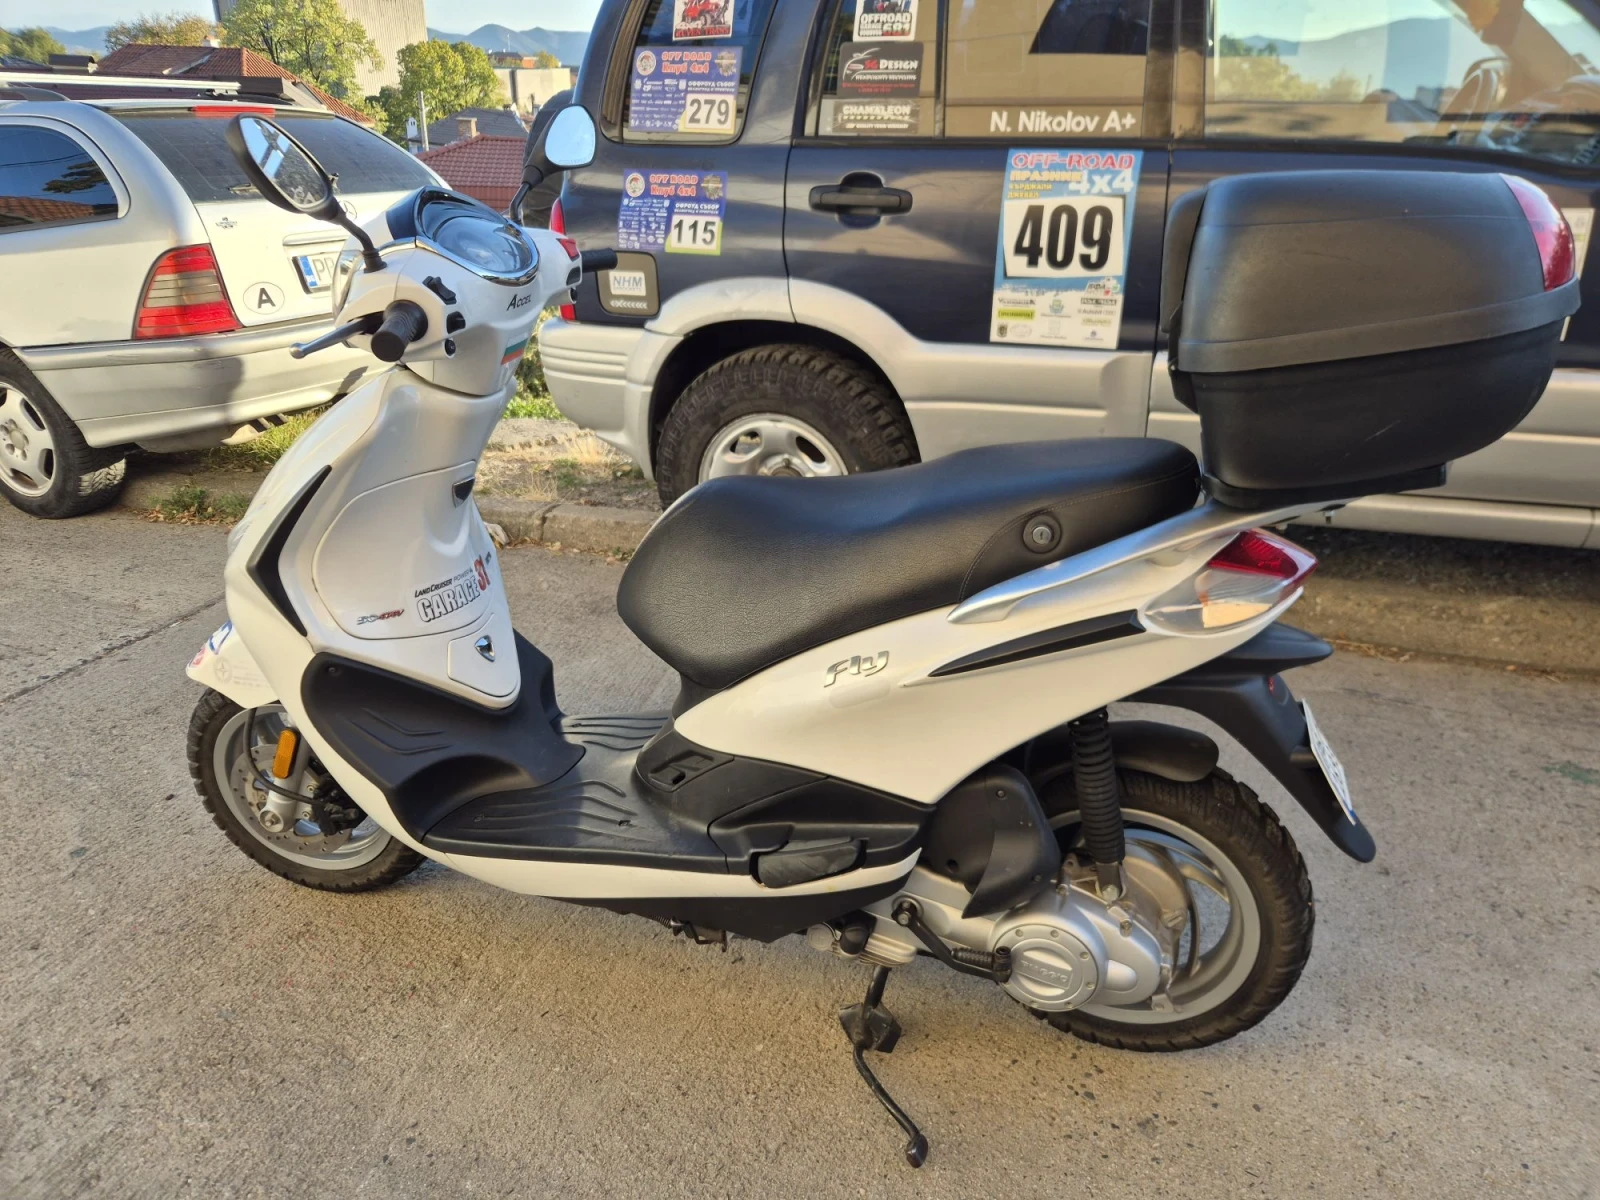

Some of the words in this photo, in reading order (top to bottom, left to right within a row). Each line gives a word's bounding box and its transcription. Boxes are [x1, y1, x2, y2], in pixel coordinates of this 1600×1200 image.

[860, 12, 912, 24] OFFROAD
[661, 51, 682, 61] OFF
[682, 51, 712, 61] ROAD
[688, 98, 730, 125] 279
[989, 110, 1012, 133] N.
[1018, 110, 1100, 133] Nikolov
[1102, 109, 1137, 133] A+
[1011, 152, 1136, 170] OFF-ROAD
[649, 174, 669, 184] OFF
[670, 174, 698, 184] ROAD
[673, 219, 716, 246] 115
[1014, 204, 1114, 271] 409
[613, 275, 642, 288] NHM
[257, 287, 276, 309] A
[416, 575, 481, 623] GARAGE
